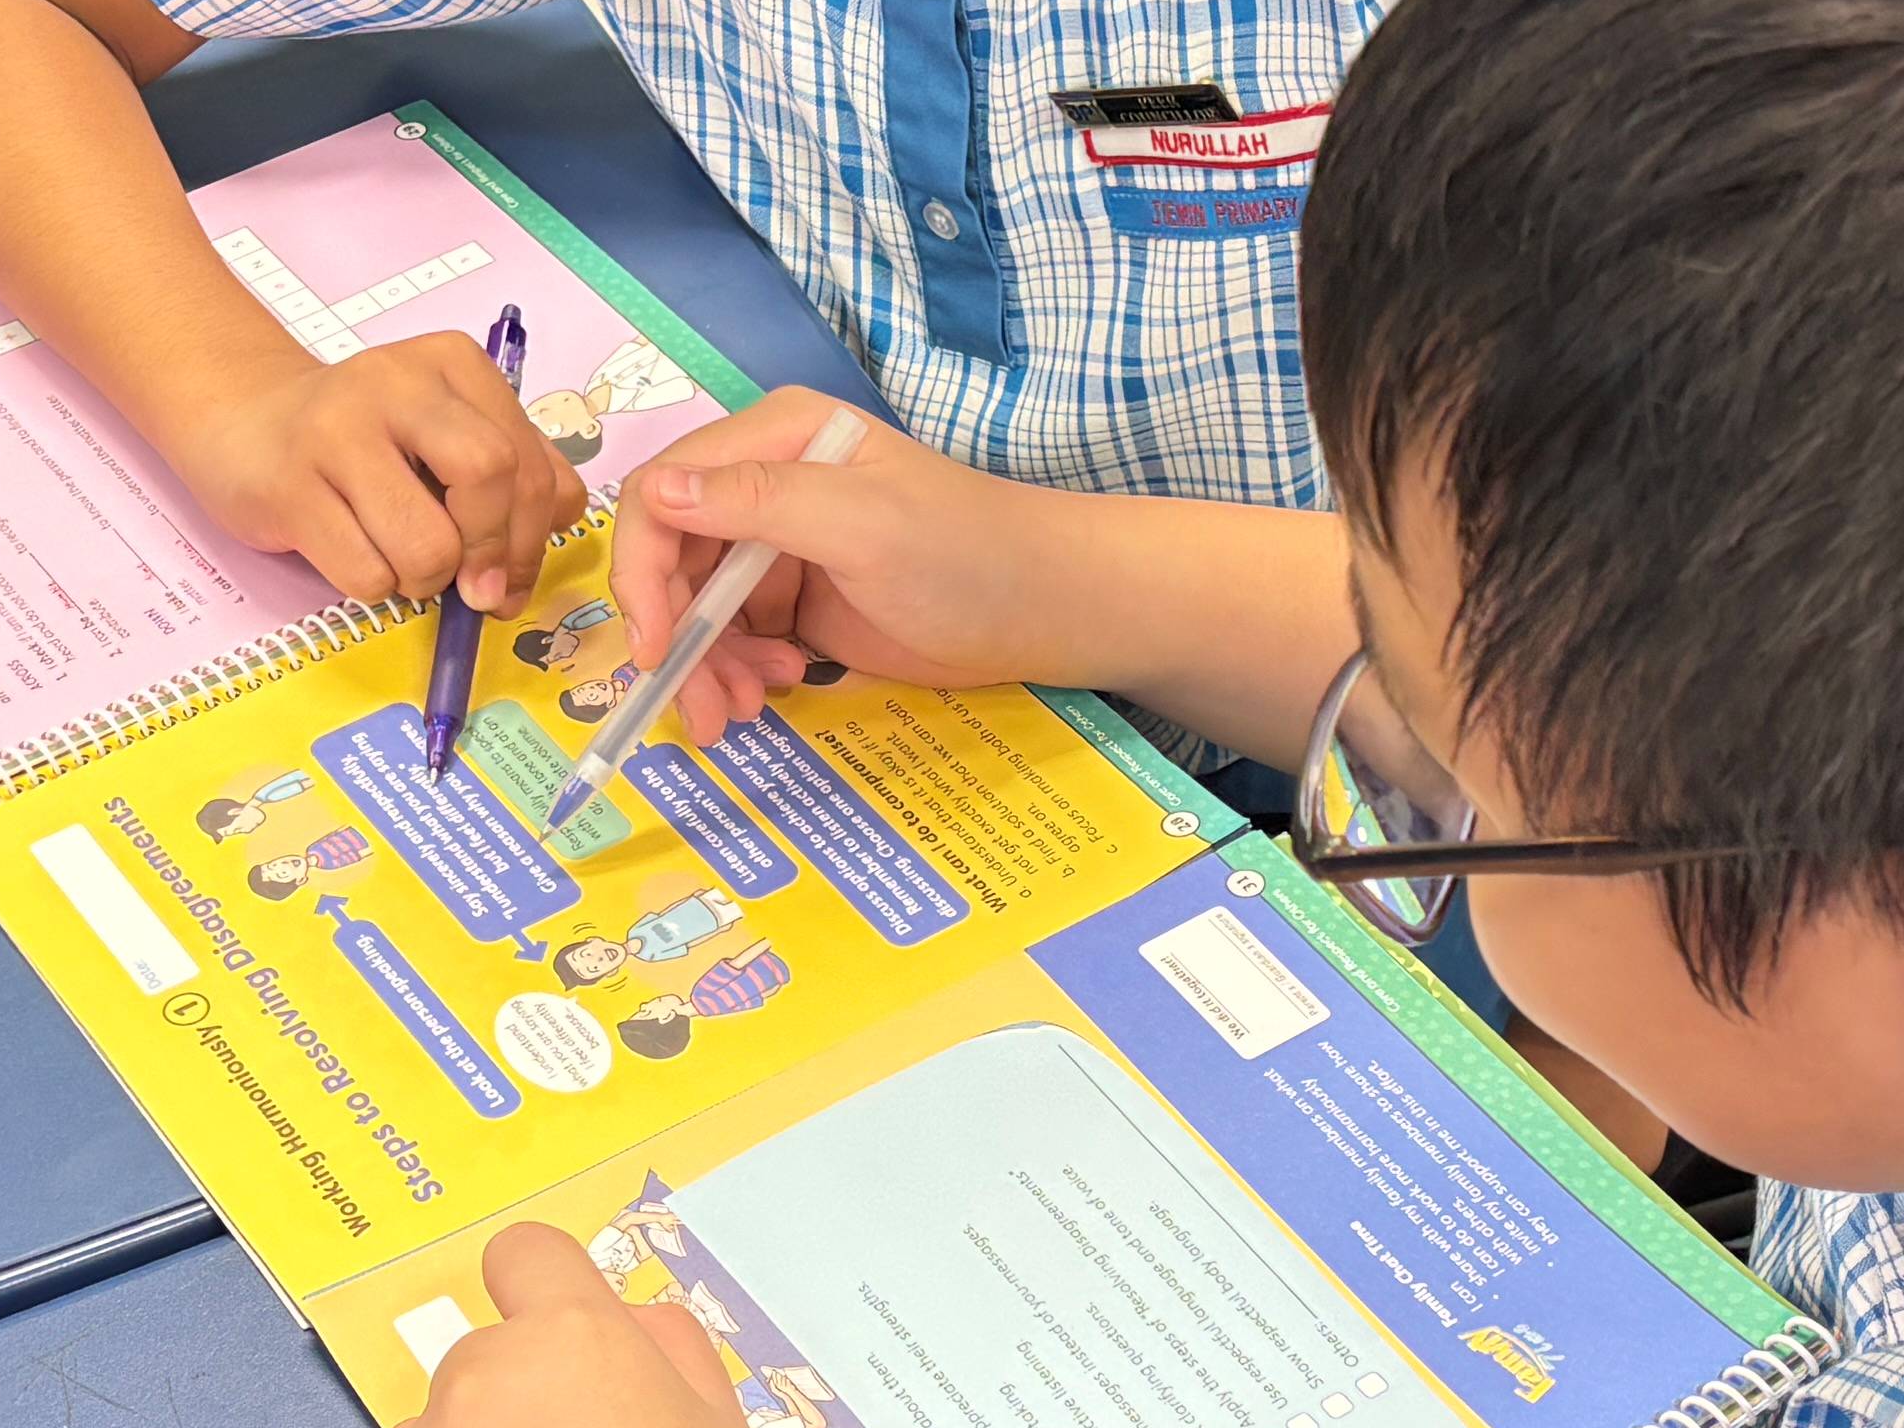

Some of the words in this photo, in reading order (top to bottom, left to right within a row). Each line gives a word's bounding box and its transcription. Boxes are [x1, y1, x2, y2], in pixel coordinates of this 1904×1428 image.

[1150, 128, 1270, 157] NURULLAH
[845, 720, 864, 736] do
[350, 731, 390, 773] saying
[737, 730, 772, 764] when
[860, 741, 879, 752] if
[873, 750, 906, 777] okay
[885, 730, 919, 763] want.
[340, 752, 404, 822] respectfully.
[384, 771, 407, 793] are
[442, 771, 472, 795] you
[640, 765, 664, 788] the
[666, 759, 697, 792] view.
[739, 765, 776, 792] your
[766, 761, 815, 807] actively
[791, 755, 832, 794] option
[813, 729, 904, 810] compromise?
[902, 776, 917, 788] is
[919, 766, 955, 797] what
[400, 790, 432, 815] you
[461, 792, 490, 819] why
[659, 785, 677, 802] to
[827, 792, 854, 816] one
[911, 786, 928, 798] it
[922, 796, 952, 823] that
[418, 811, 453, 845] what
[671, 798, 723, 848] carefully
[692, 789, 748, 838] person's
[766, 790, 813, 834] achieve
[810, 804, 847, 840] listen
[901, 809, 920, 827] to
[950, 795, 996, 835] exactly
[392, 819, 424, 845] and
[455, 821, 486, 848] feel
[484, 816, 526, 857] reason
[809, 833, 826, 849] to
[842, 836, 860, 853] to
[850, 814, 895, 858] Choose
[916, 825, 938, 843] do
[990, 833, 1021, 855] get
[417, 843, 469, 894] sincerely
[482, 849, 510, 874] but
[519, 854, 534, 866] a
[718, 846, 757, 884] Listen
[736, 836, 773, 868] other
[821, 846, 869, 892] options
[941, 848, 970, 874] can
[943, 820, 1018, 887] Understand
[1011, 853, 1039, 875] not
[89, 786, 255, 971] Disagreements
[442, 841, 512, 909] understand
[528, 864, 557, 893] Give
[854, 851, 923, 916] Remember
[893, 855, 957, 918] discussing.
[1018, 884, 1032, 898] a.
[1236, 875, 1258, 893] 31
[461, 892, 489, 918] Say
[963, 873, 1007, 914] What
[864, 890, 912, 936] Discuss
[355, 933, 410, 994] speaking.
[243, 966, 355, 1094] Resolving
[402, 991, 450, 1036] person
[439, 1034, 464, 1060] the
[455, 1055, 478, 1074] at
[195, 1024, 308, 1155] Harmoniously
[345, 1089, 380, 1124] to
[469, 1071, 505, 1108] Look
[370, 1123, 443, 1202] Steps
[1061, 1163, 1093, 1197] voice.
[298, 1150, 371, 1238] Working
[1084, 1196, 1106, 1210] of
[1102, 1209, 1133, 1240] tone
[1148, 1199, 1205, 1263] language.
[1349, 1219, 1384, 1256] Time
[962, 1222, 1046, 1310] you-messages.
[1124, 1237, 1155, 1263] and
[1378, 1250, 1413, 1284] Chat
[1152, 1262, 1210, 1325] language
[1200, 1259, 1234, 1295] body
[857, 1280, 912, 1341] strengths.
[1032, 1309, 1054, 1324] of
[1227, 1291, 1291, 1353] respectful
[1409, 1282, 1458, 1328] Family
[1085, 1300, 1143, 1366] questions.
[1145, 1318, 1167, 1333] of
[905, 1340, 936, 1372] their
[1047, 1323, 1097, 1374] instead
[1163, 1332, 1199, 1368] steps
[1202, 1320, 1267, 1383] respectful
[1313, 1320, 1359, 1368] Others:
[866, 1350, 899, 1390] them.
[1015, 1338, 1067, 1400] listening.
[1194, 1366, 1219, 1392] the
[1285, 1352, 1325, 1390] Show
[893, 1387, 933, 1428] about
[1138, 1363, 1196, 1425] clarifying
[1214, 1390, 1255, 1428] Apply
[1262, 1382, 1288, 1410] Use
